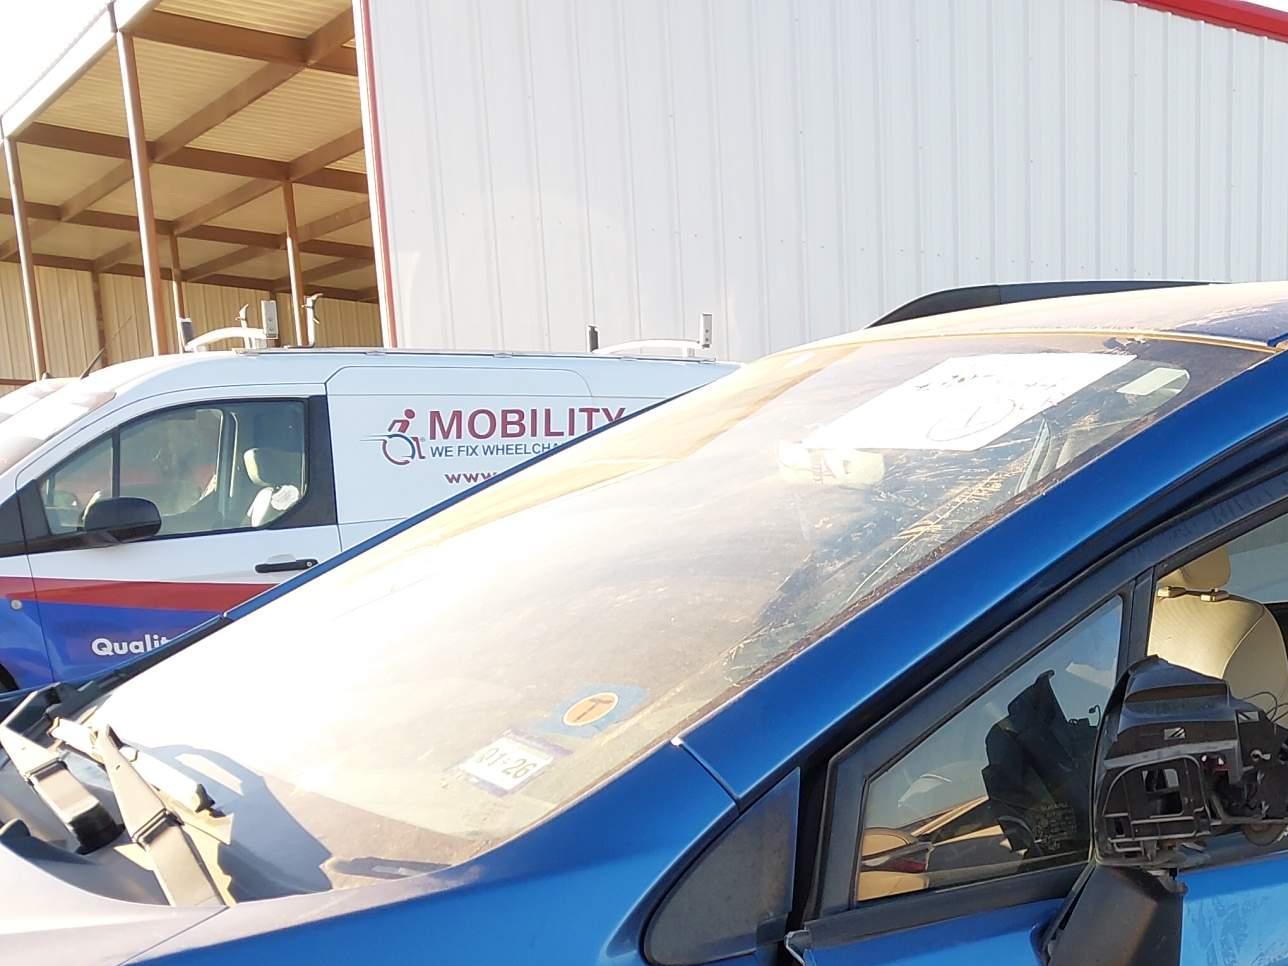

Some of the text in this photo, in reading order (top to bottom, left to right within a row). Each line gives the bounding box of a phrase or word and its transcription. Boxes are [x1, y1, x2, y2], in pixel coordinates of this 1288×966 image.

[429, 407, 626, 441] MOBILITY
[430, 442, 559, 458] WE FIX WHEELCH
